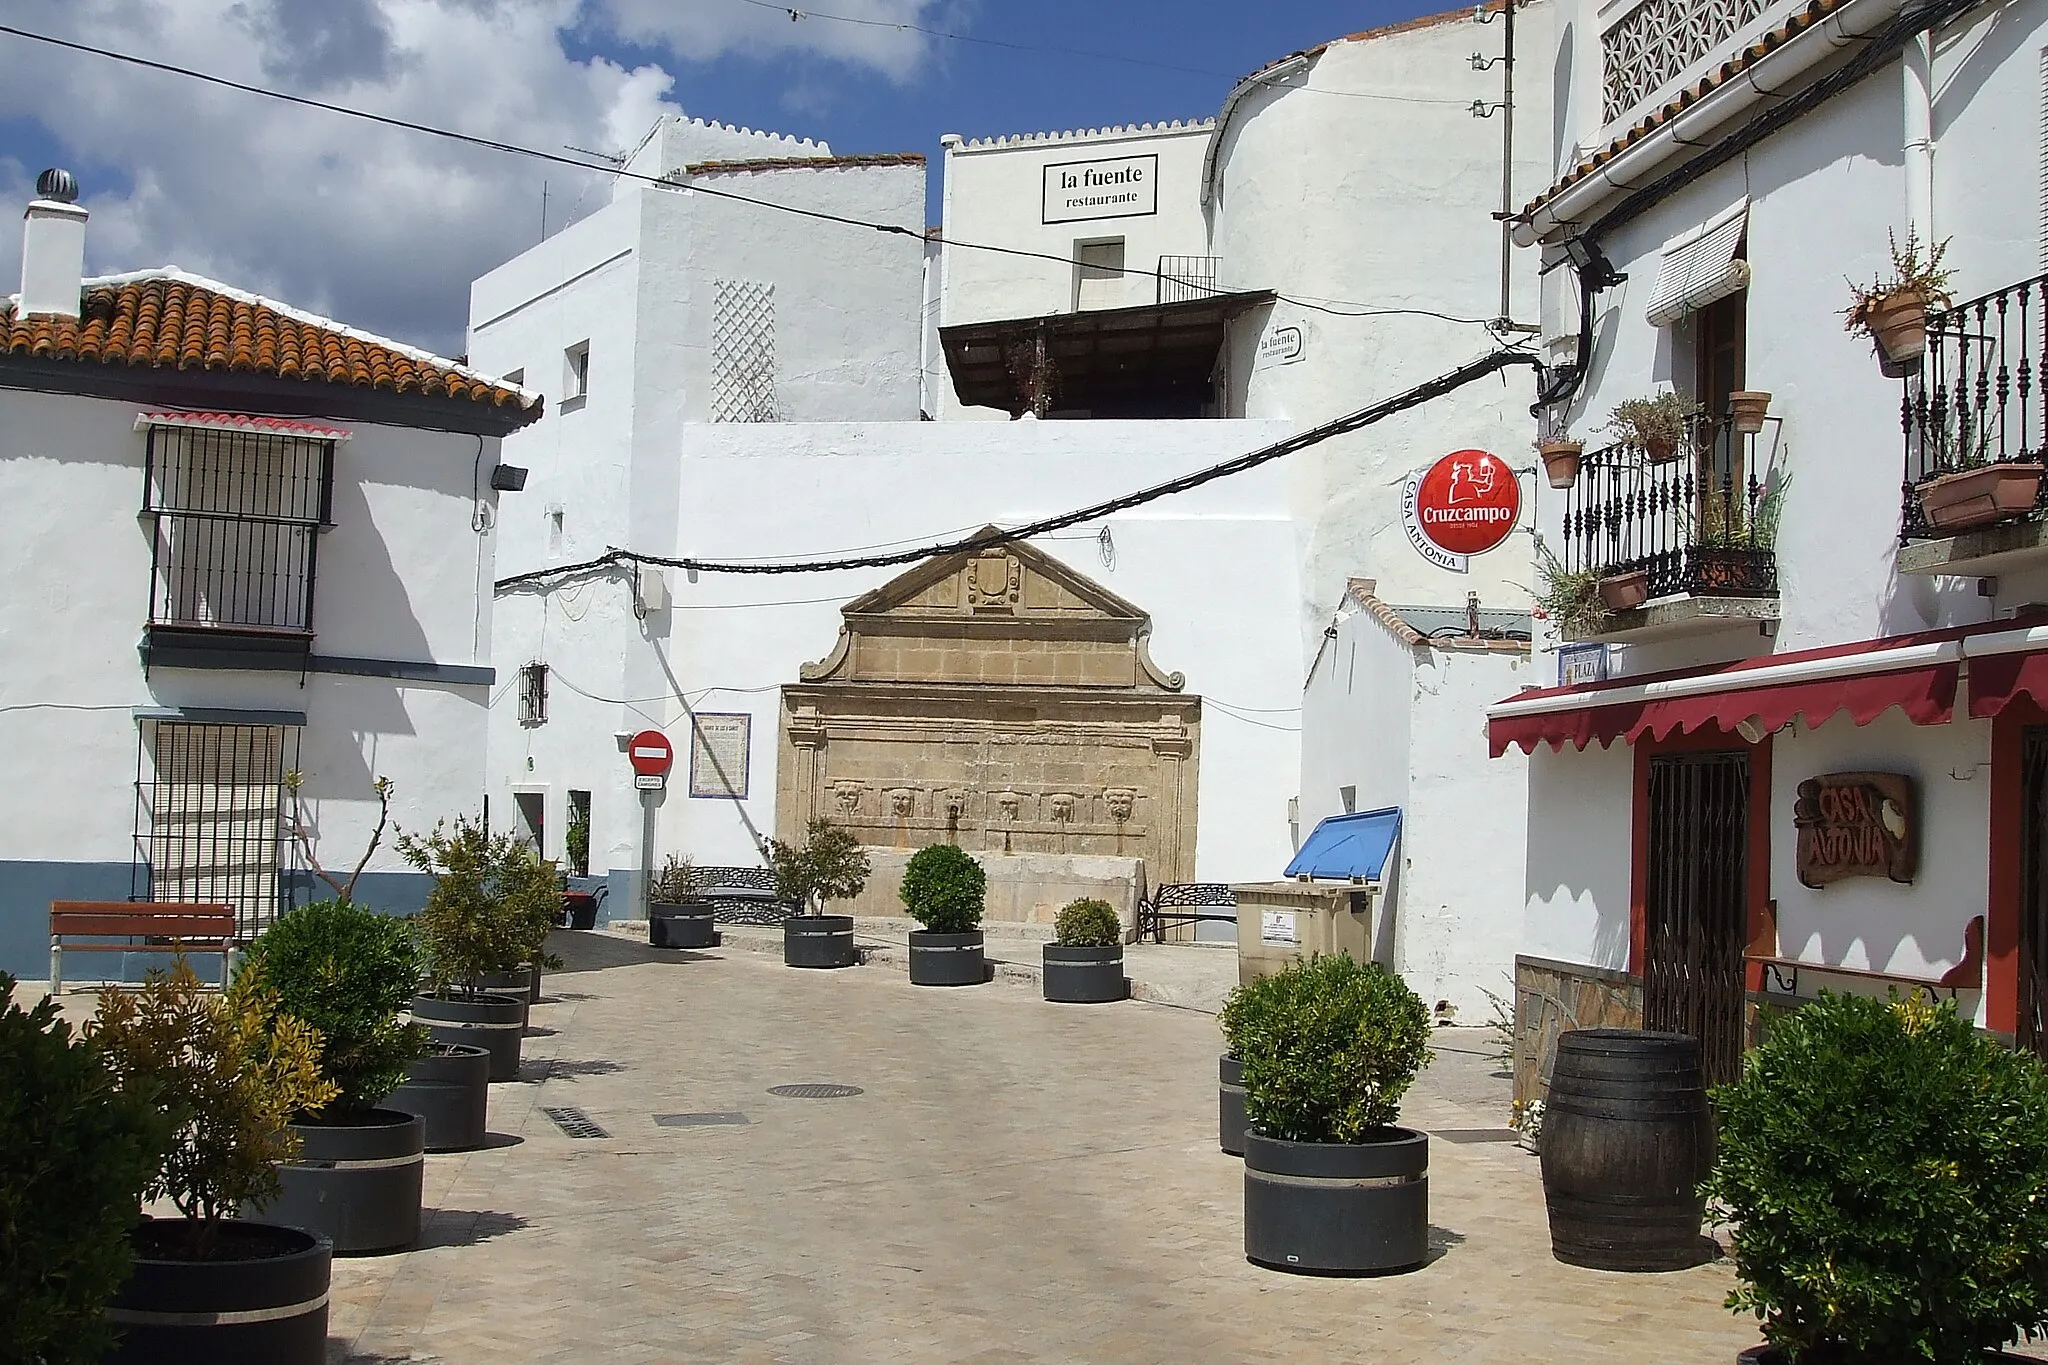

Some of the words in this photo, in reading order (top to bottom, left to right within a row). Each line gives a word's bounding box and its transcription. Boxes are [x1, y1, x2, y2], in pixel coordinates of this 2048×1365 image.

[1061, 171, 1077, 189] la
[1083, 166, 1143, 187] fuente
[1066, 192, 1138, 208] restaurante
[1270, 334, 1295, 347] fuente
[1404, 481, 1417, 519] CASA
[1423, 507, 1511, 524] Cruzcampo
[1407, 524, 1456, 567] ANTONIA
[1574, 662, 1596, 679] PLAZA
[1820, 786, 1871, 821] CASA
